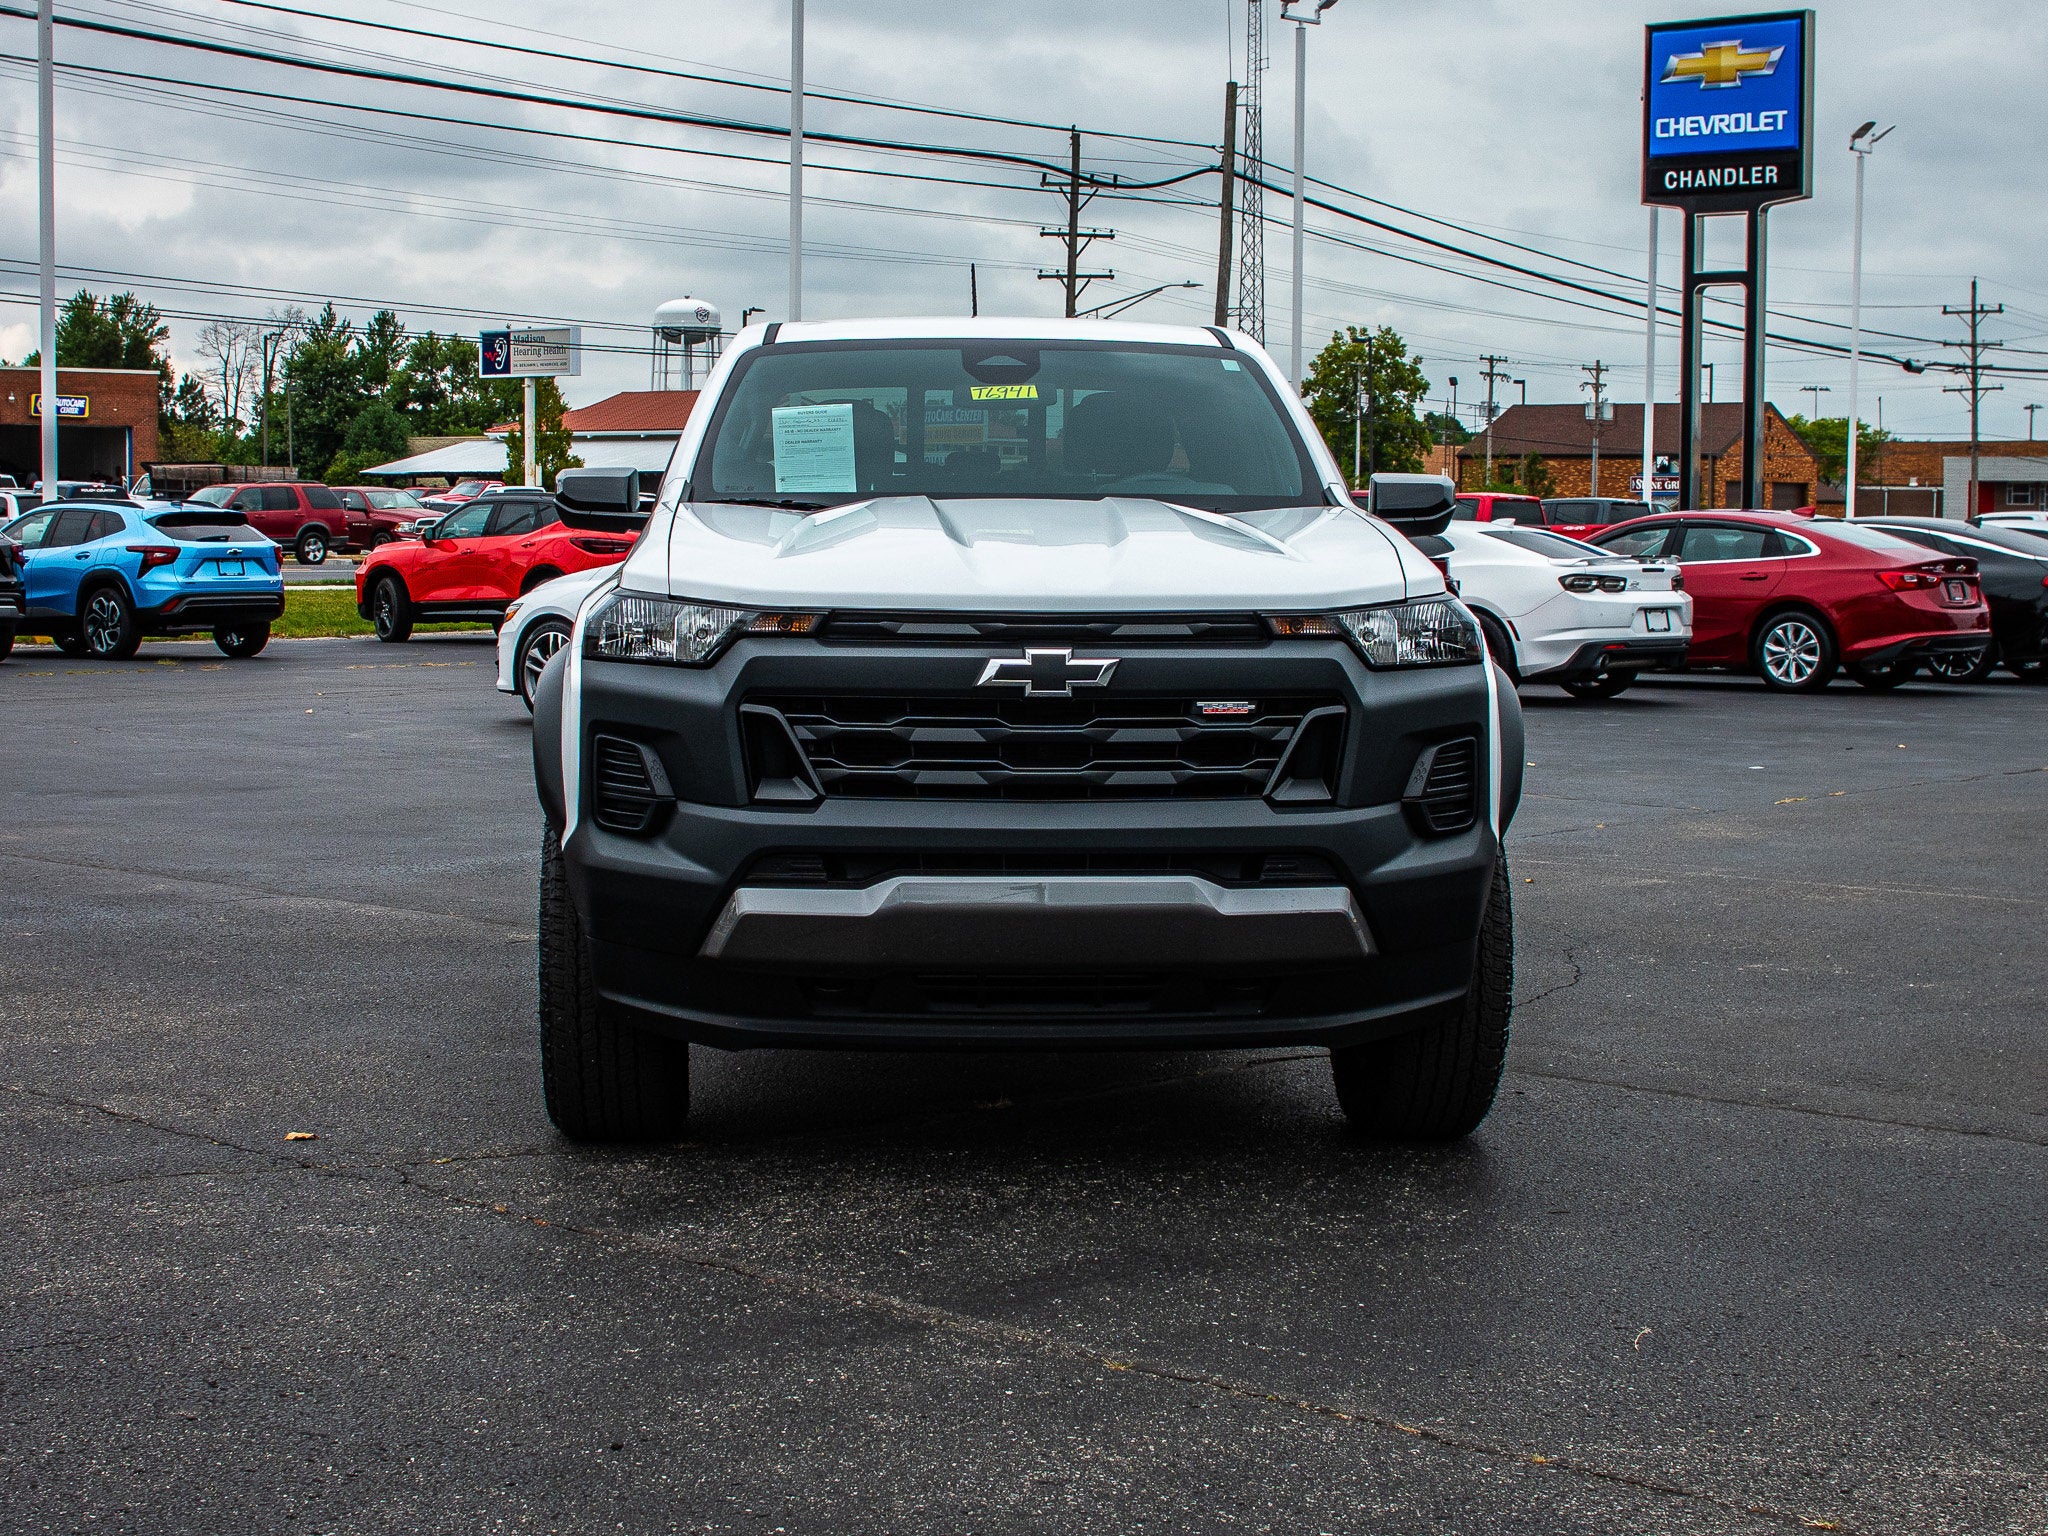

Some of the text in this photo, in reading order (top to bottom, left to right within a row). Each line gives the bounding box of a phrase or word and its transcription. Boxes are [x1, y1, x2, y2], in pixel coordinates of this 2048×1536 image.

[1655, 110, 1788, 138] CHEVROLET
[1664, 166, 1779, 189] CHANDLER
[513, 334, 546, 344] Madison
[513, 345, 567, 358] Hearing Health
[972, 386, 1032, 399] T6941
[955, 408, 982, 422] CENTER
[1636, 479, 1662, 489] SNE
